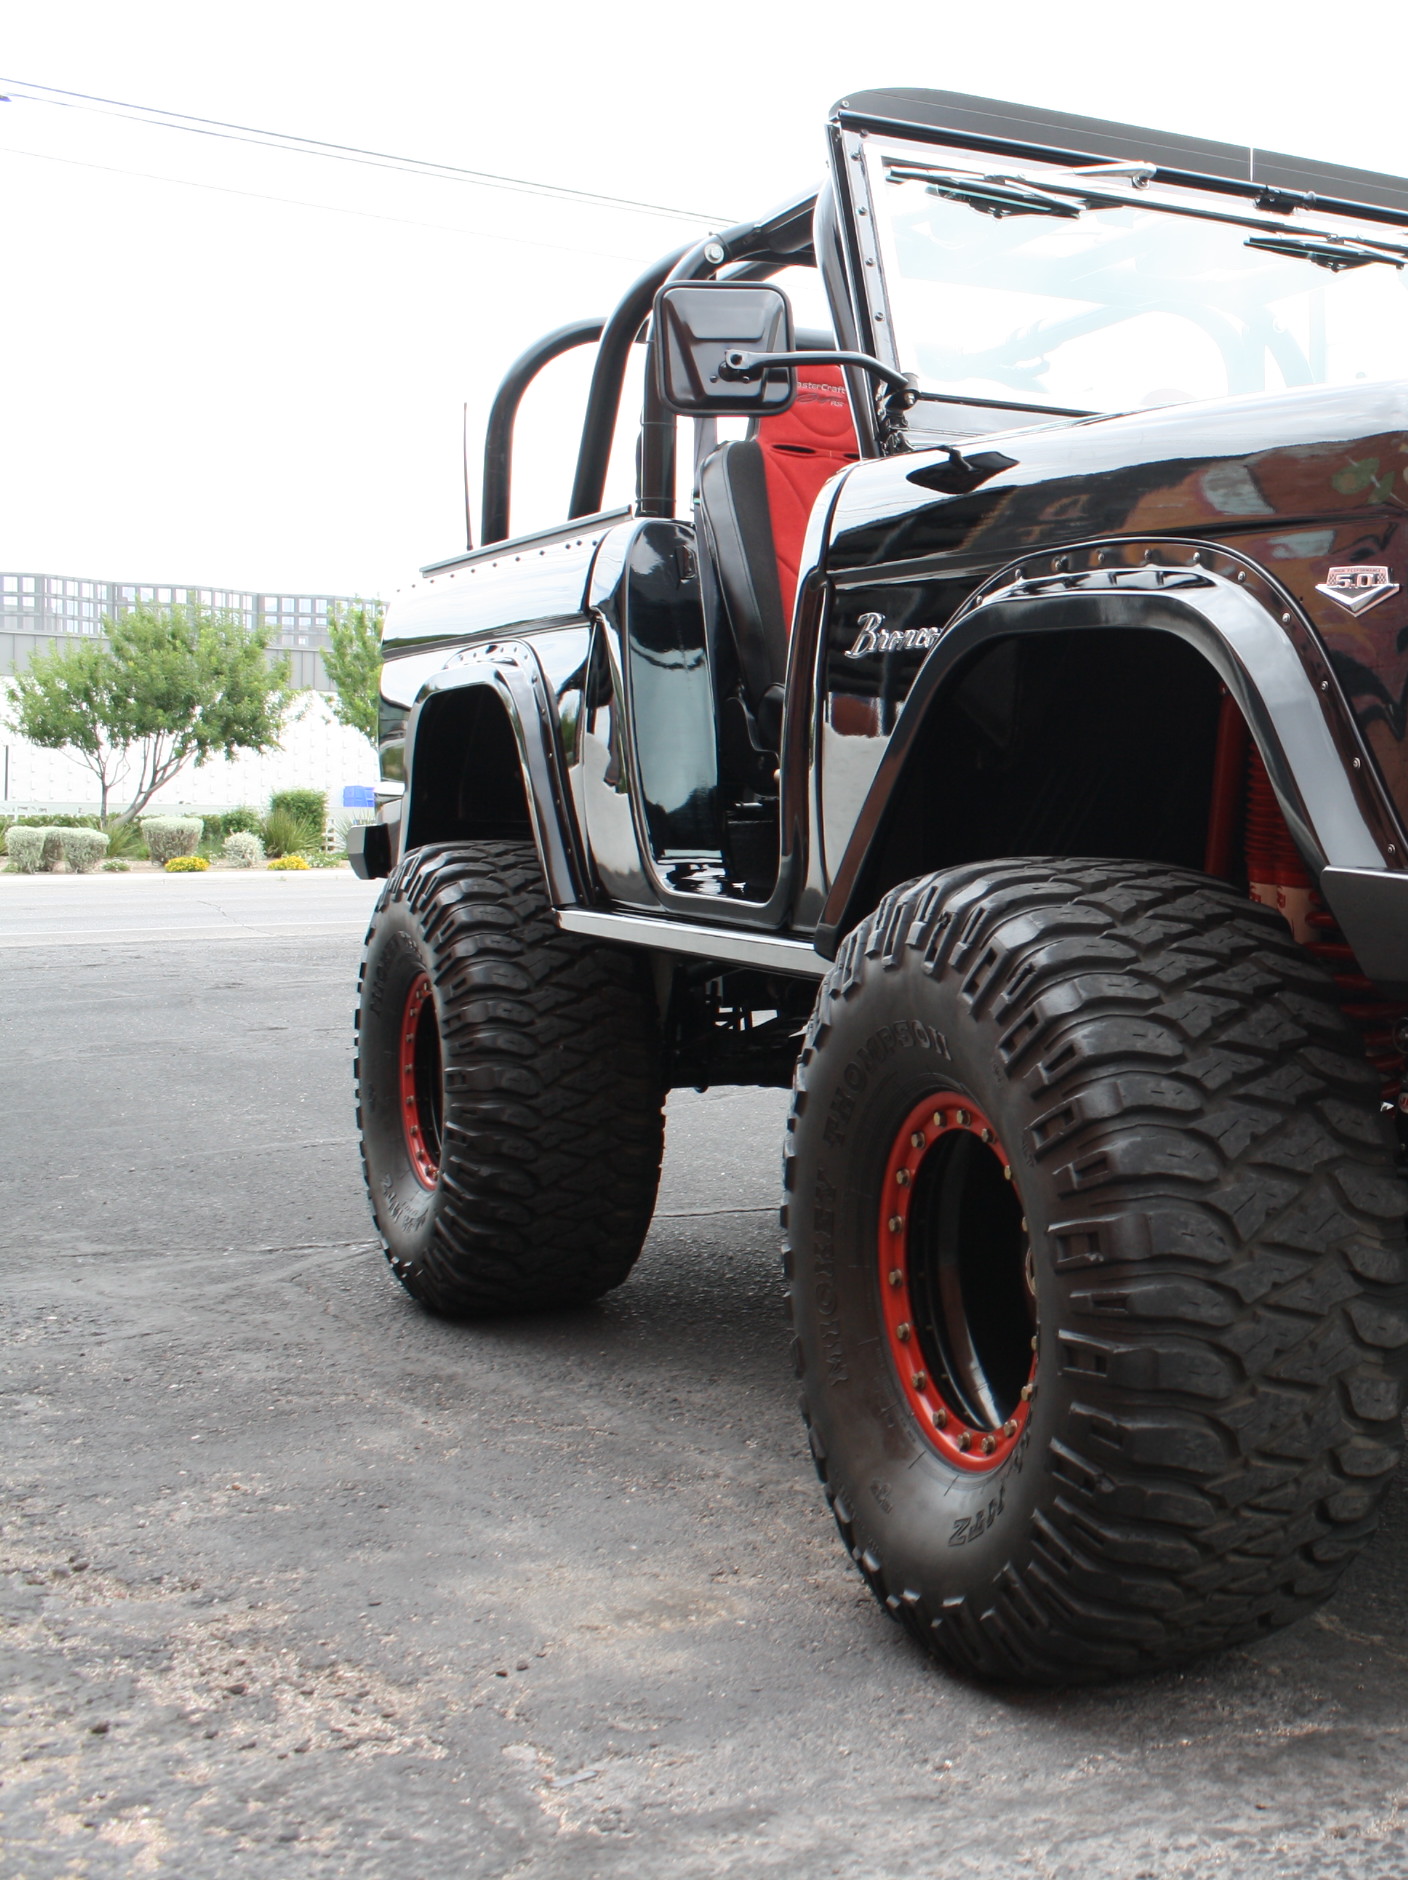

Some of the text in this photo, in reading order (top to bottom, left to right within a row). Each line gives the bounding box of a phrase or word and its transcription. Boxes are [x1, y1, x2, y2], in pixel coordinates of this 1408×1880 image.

[797, 381, 846, 395] asterCraft
[1335, 573, 1375, 589] 5.0
[843, 612, 942, 660] Bronco
